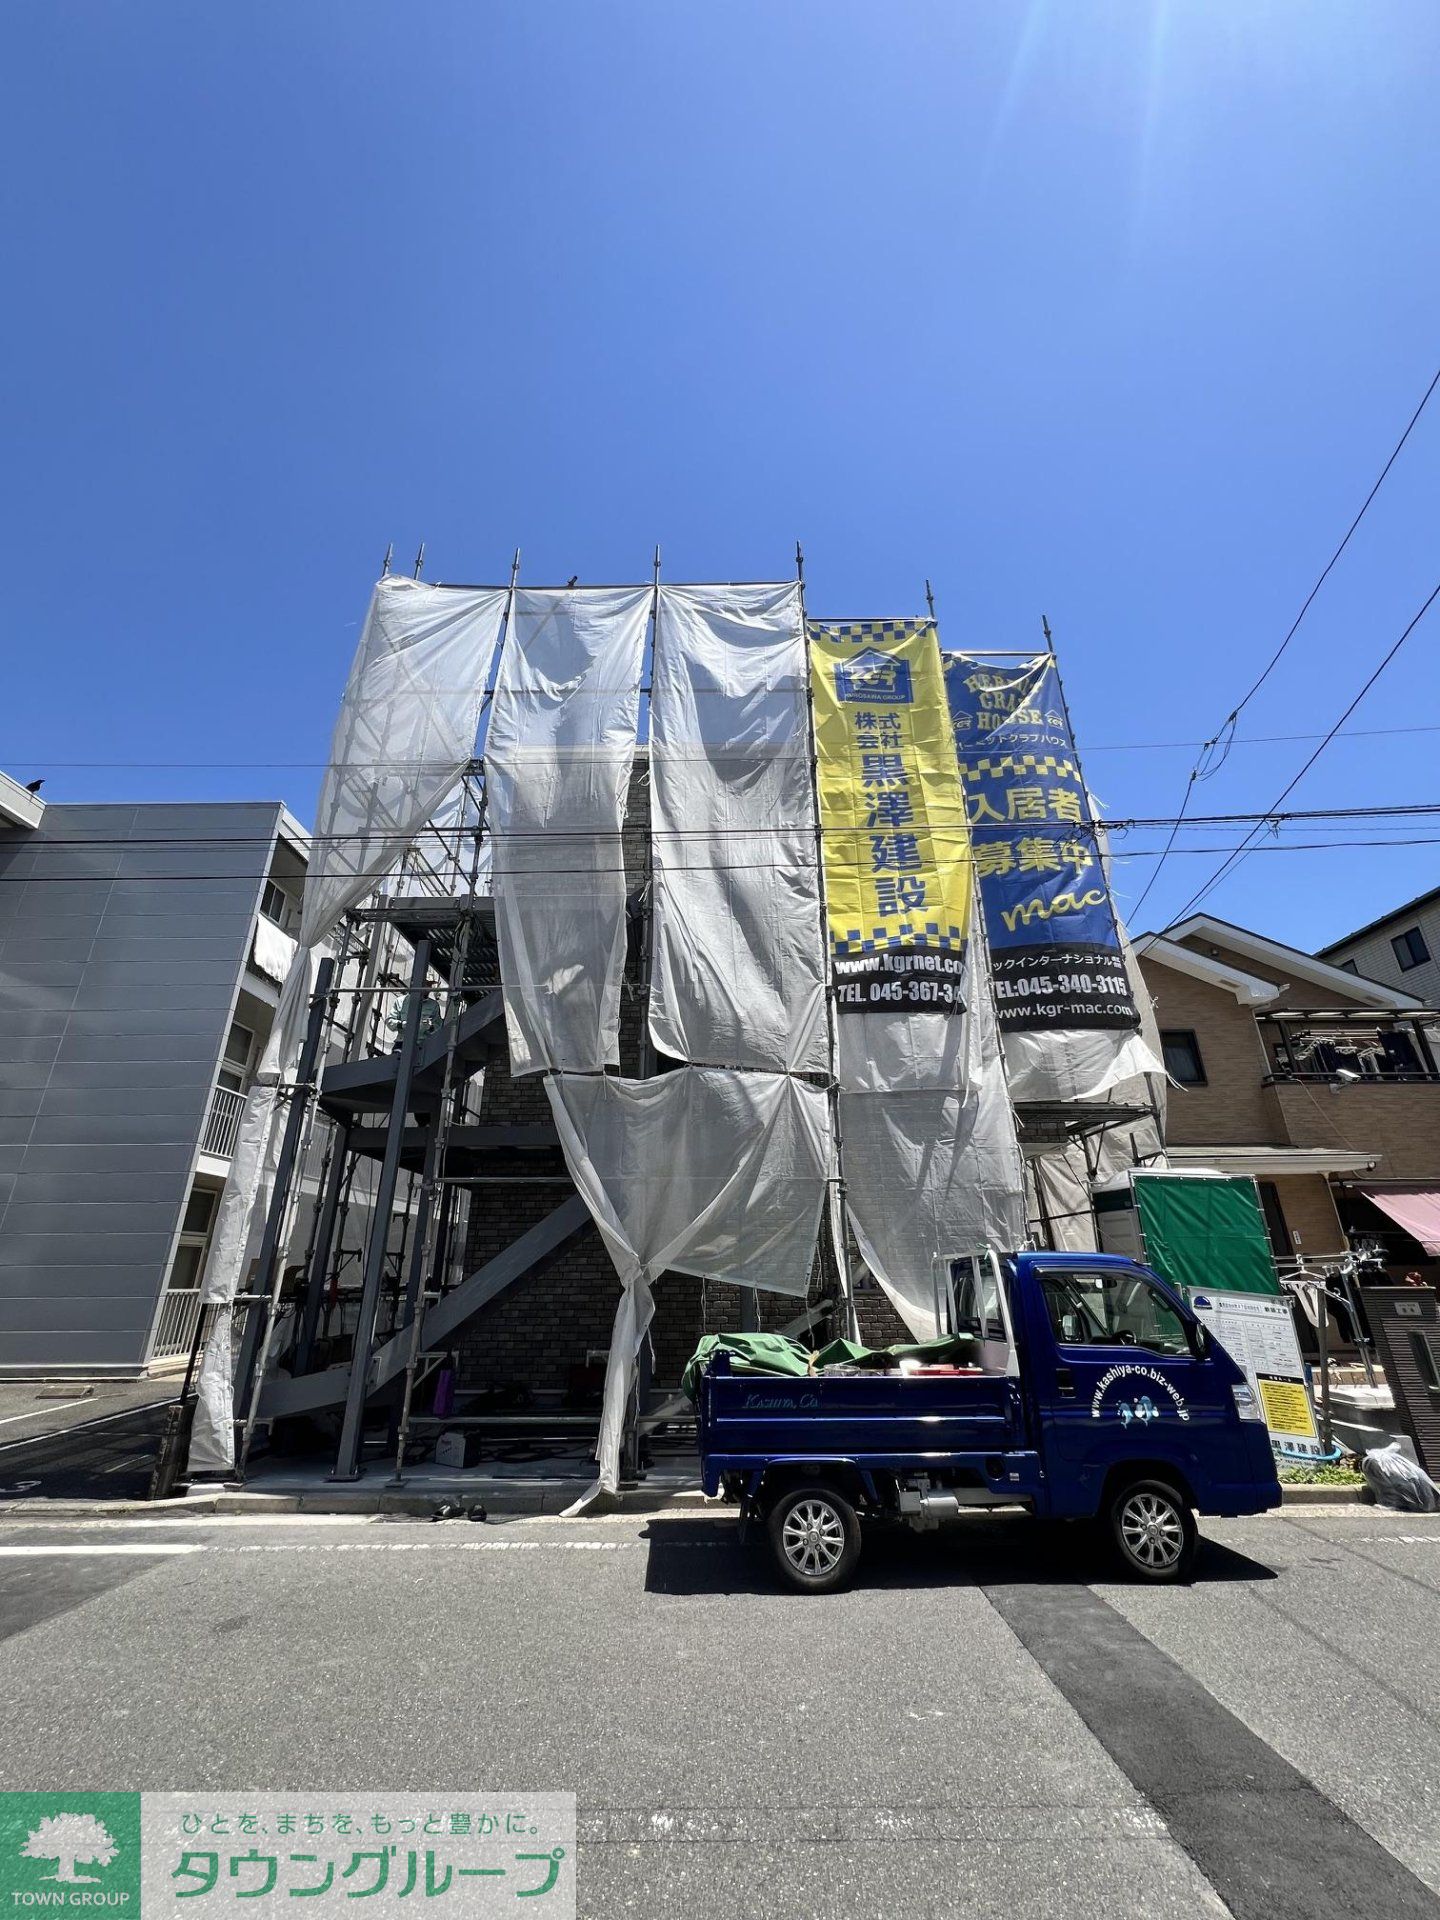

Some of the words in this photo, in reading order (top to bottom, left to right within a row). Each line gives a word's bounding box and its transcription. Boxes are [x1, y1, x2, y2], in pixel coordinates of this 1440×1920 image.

[855, 712, 901, 730] 株式
[857, 731, 903, 749] 会社
[967, 787, 1082, 824] 入居者
[861, 753, 929, 917] 黒澤建設
[971, 837, 1093, 877] 募集中
[1002, 888, 1107, 933] mac
[837, 983, 867, 1003] TEL.
[993, 974, 1128, 999] EL:045-340-3115
[1091, 1365, 1190, 1420] www.kashiya-co.biz-web.jp
